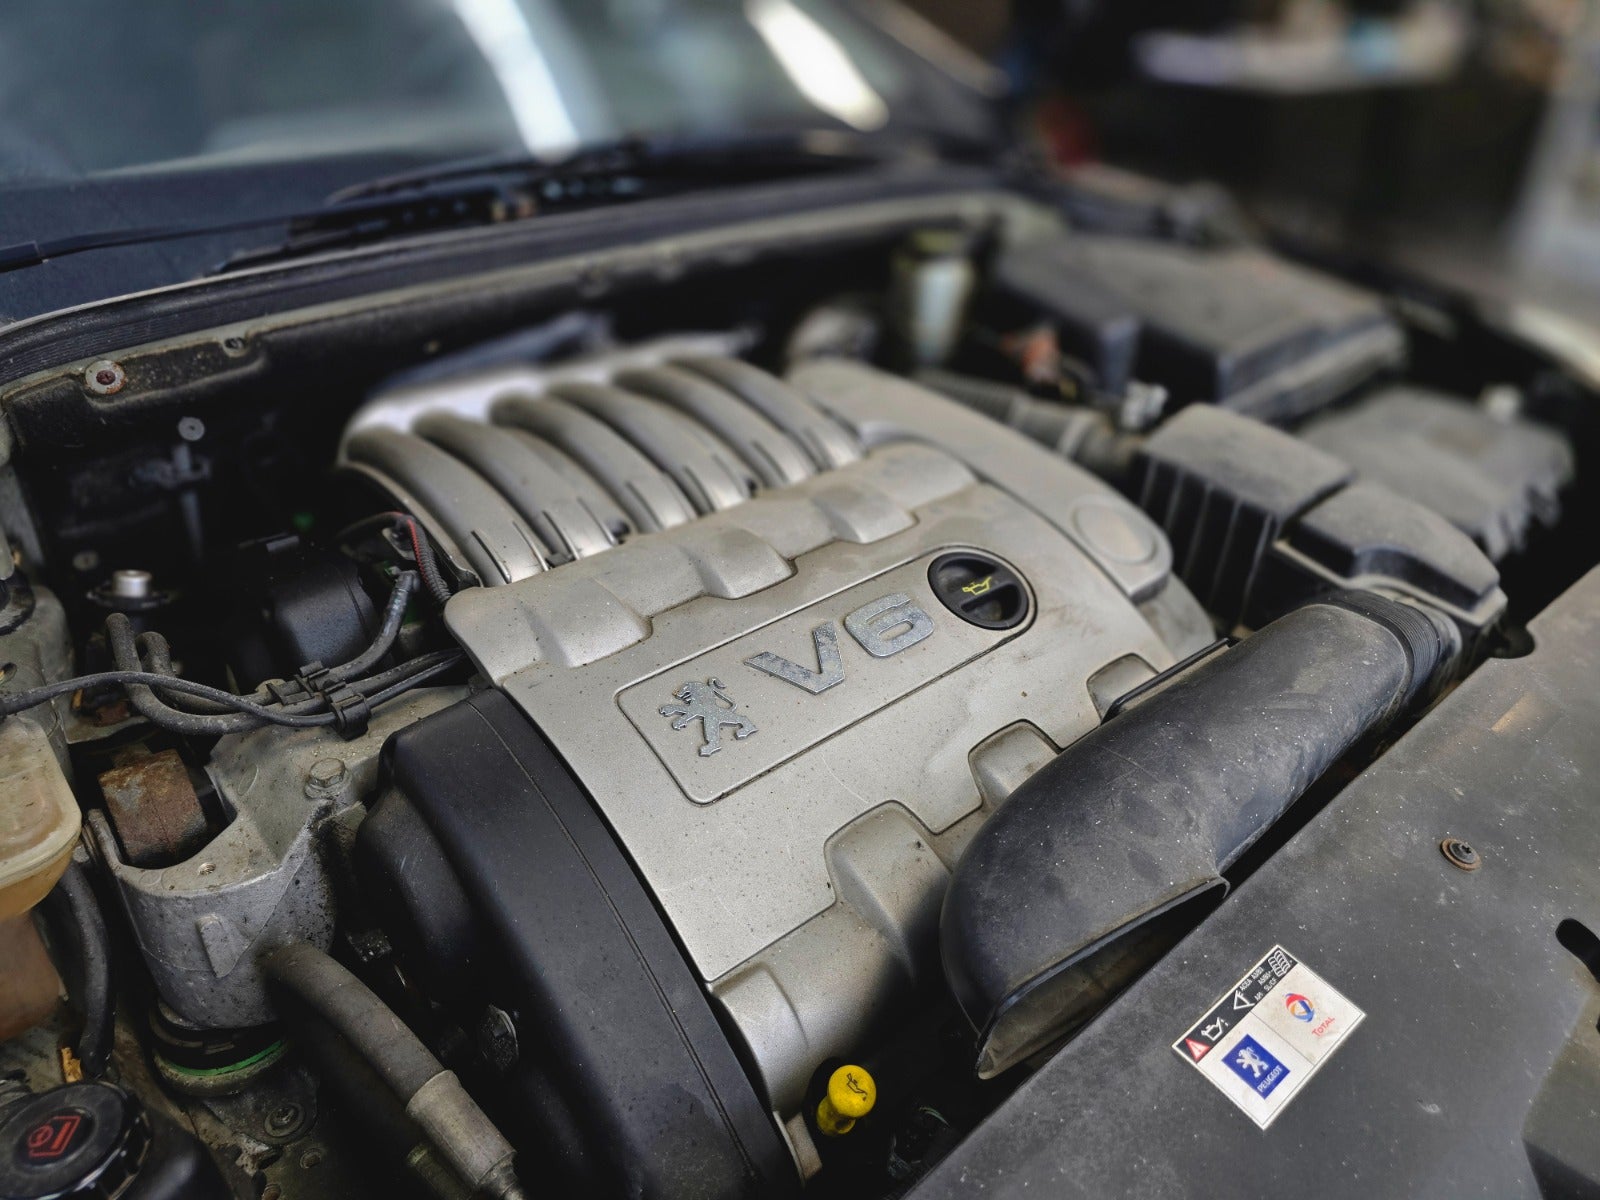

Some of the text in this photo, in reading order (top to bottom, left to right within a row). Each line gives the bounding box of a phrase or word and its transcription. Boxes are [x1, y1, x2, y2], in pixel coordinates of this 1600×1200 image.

[744, 593, 935, 695] V6
[1311, 1015, 1336, 1037] TOTAL
[1257, 1065, 1283, 1092] PEUGEOT
